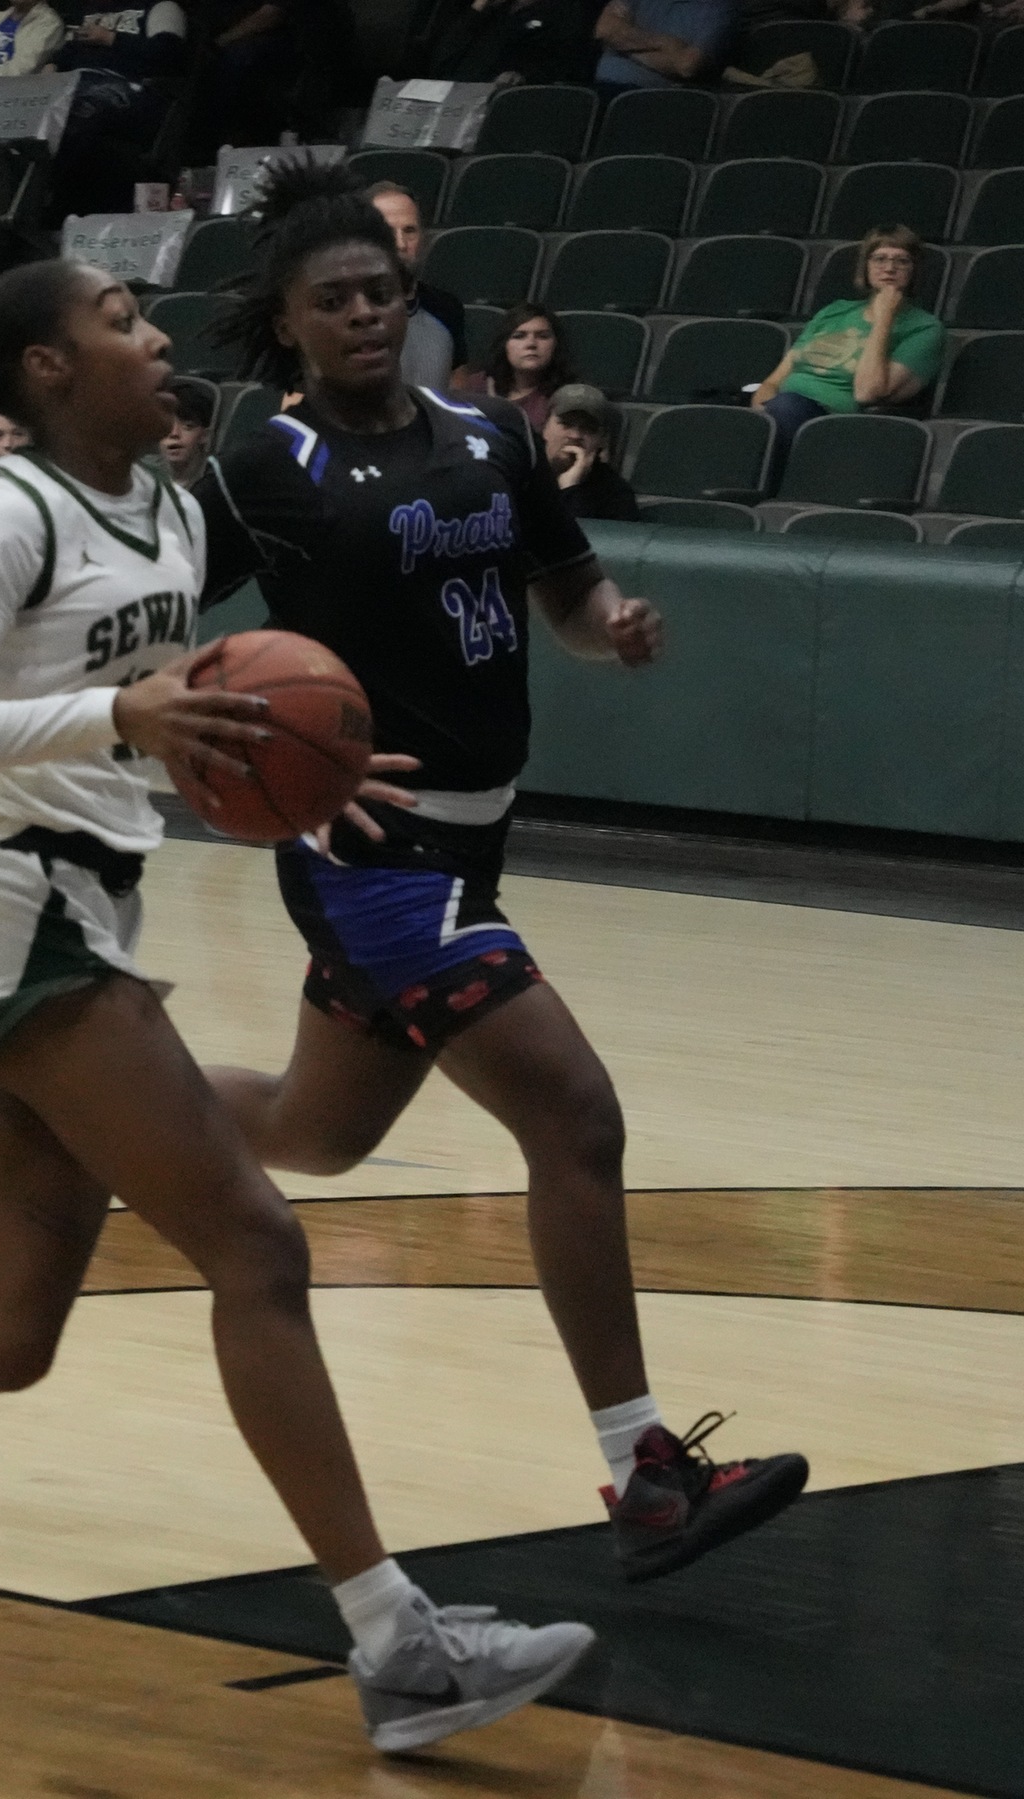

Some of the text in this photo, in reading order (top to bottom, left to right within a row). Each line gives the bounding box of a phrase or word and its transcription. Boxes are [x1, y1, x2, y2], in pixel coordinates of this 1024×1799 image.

[72, 231, 162, 250] Reserved
[388, 492, 513, 574] Pratt
[440, 566, 518, 667] 24
